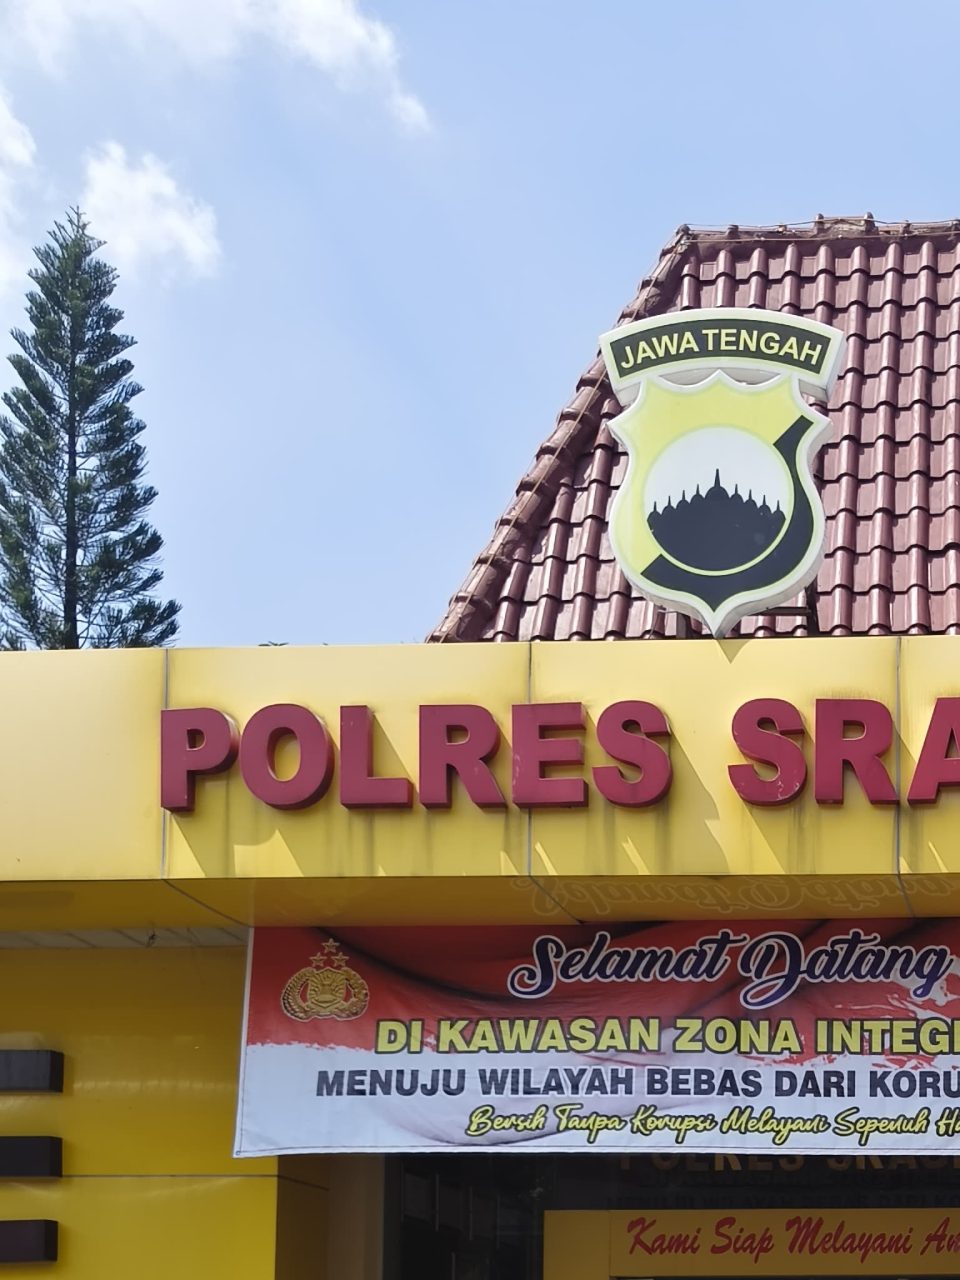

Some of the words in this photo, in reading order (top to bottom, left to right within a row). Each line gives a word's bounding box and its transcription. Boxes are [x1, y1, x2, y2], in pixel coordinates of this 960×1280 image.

[621, 331, 699, 369] JAWA
[702, 328, 822, 366] TENGAH
[161, 700, 674, 811] POLRES
[508, 930, 749, 999] Selamat
[739, 929, 956, 1009] Datang
[375, 1018, 423, 1053] DI
[436, 1018, 661, 1054] KAWASAN
[672, 1017, 804, 1054] ZONA
[316, 1069, 466, 1097] MENUJU
[479, 1068, 635, 1097] WILAYAH
[646, 1069, 763, 1099] BEBAS
[774, 1070, 856, 1098] DARI
[465, 1104, 549, 1136] Bersih
[554, 1103, 627, 1144] Tanpa
[631, 1104, 717, 1144] Korupsi
[720, 1106, 830, 1145] Melayani
[833, 1107, 931, 1146] Sepenuh
[626, 1216, 701, 1255] Kami
[710, 1217, 774, 1264] Siap
[785, 1216, 914, 1264] Melayani
